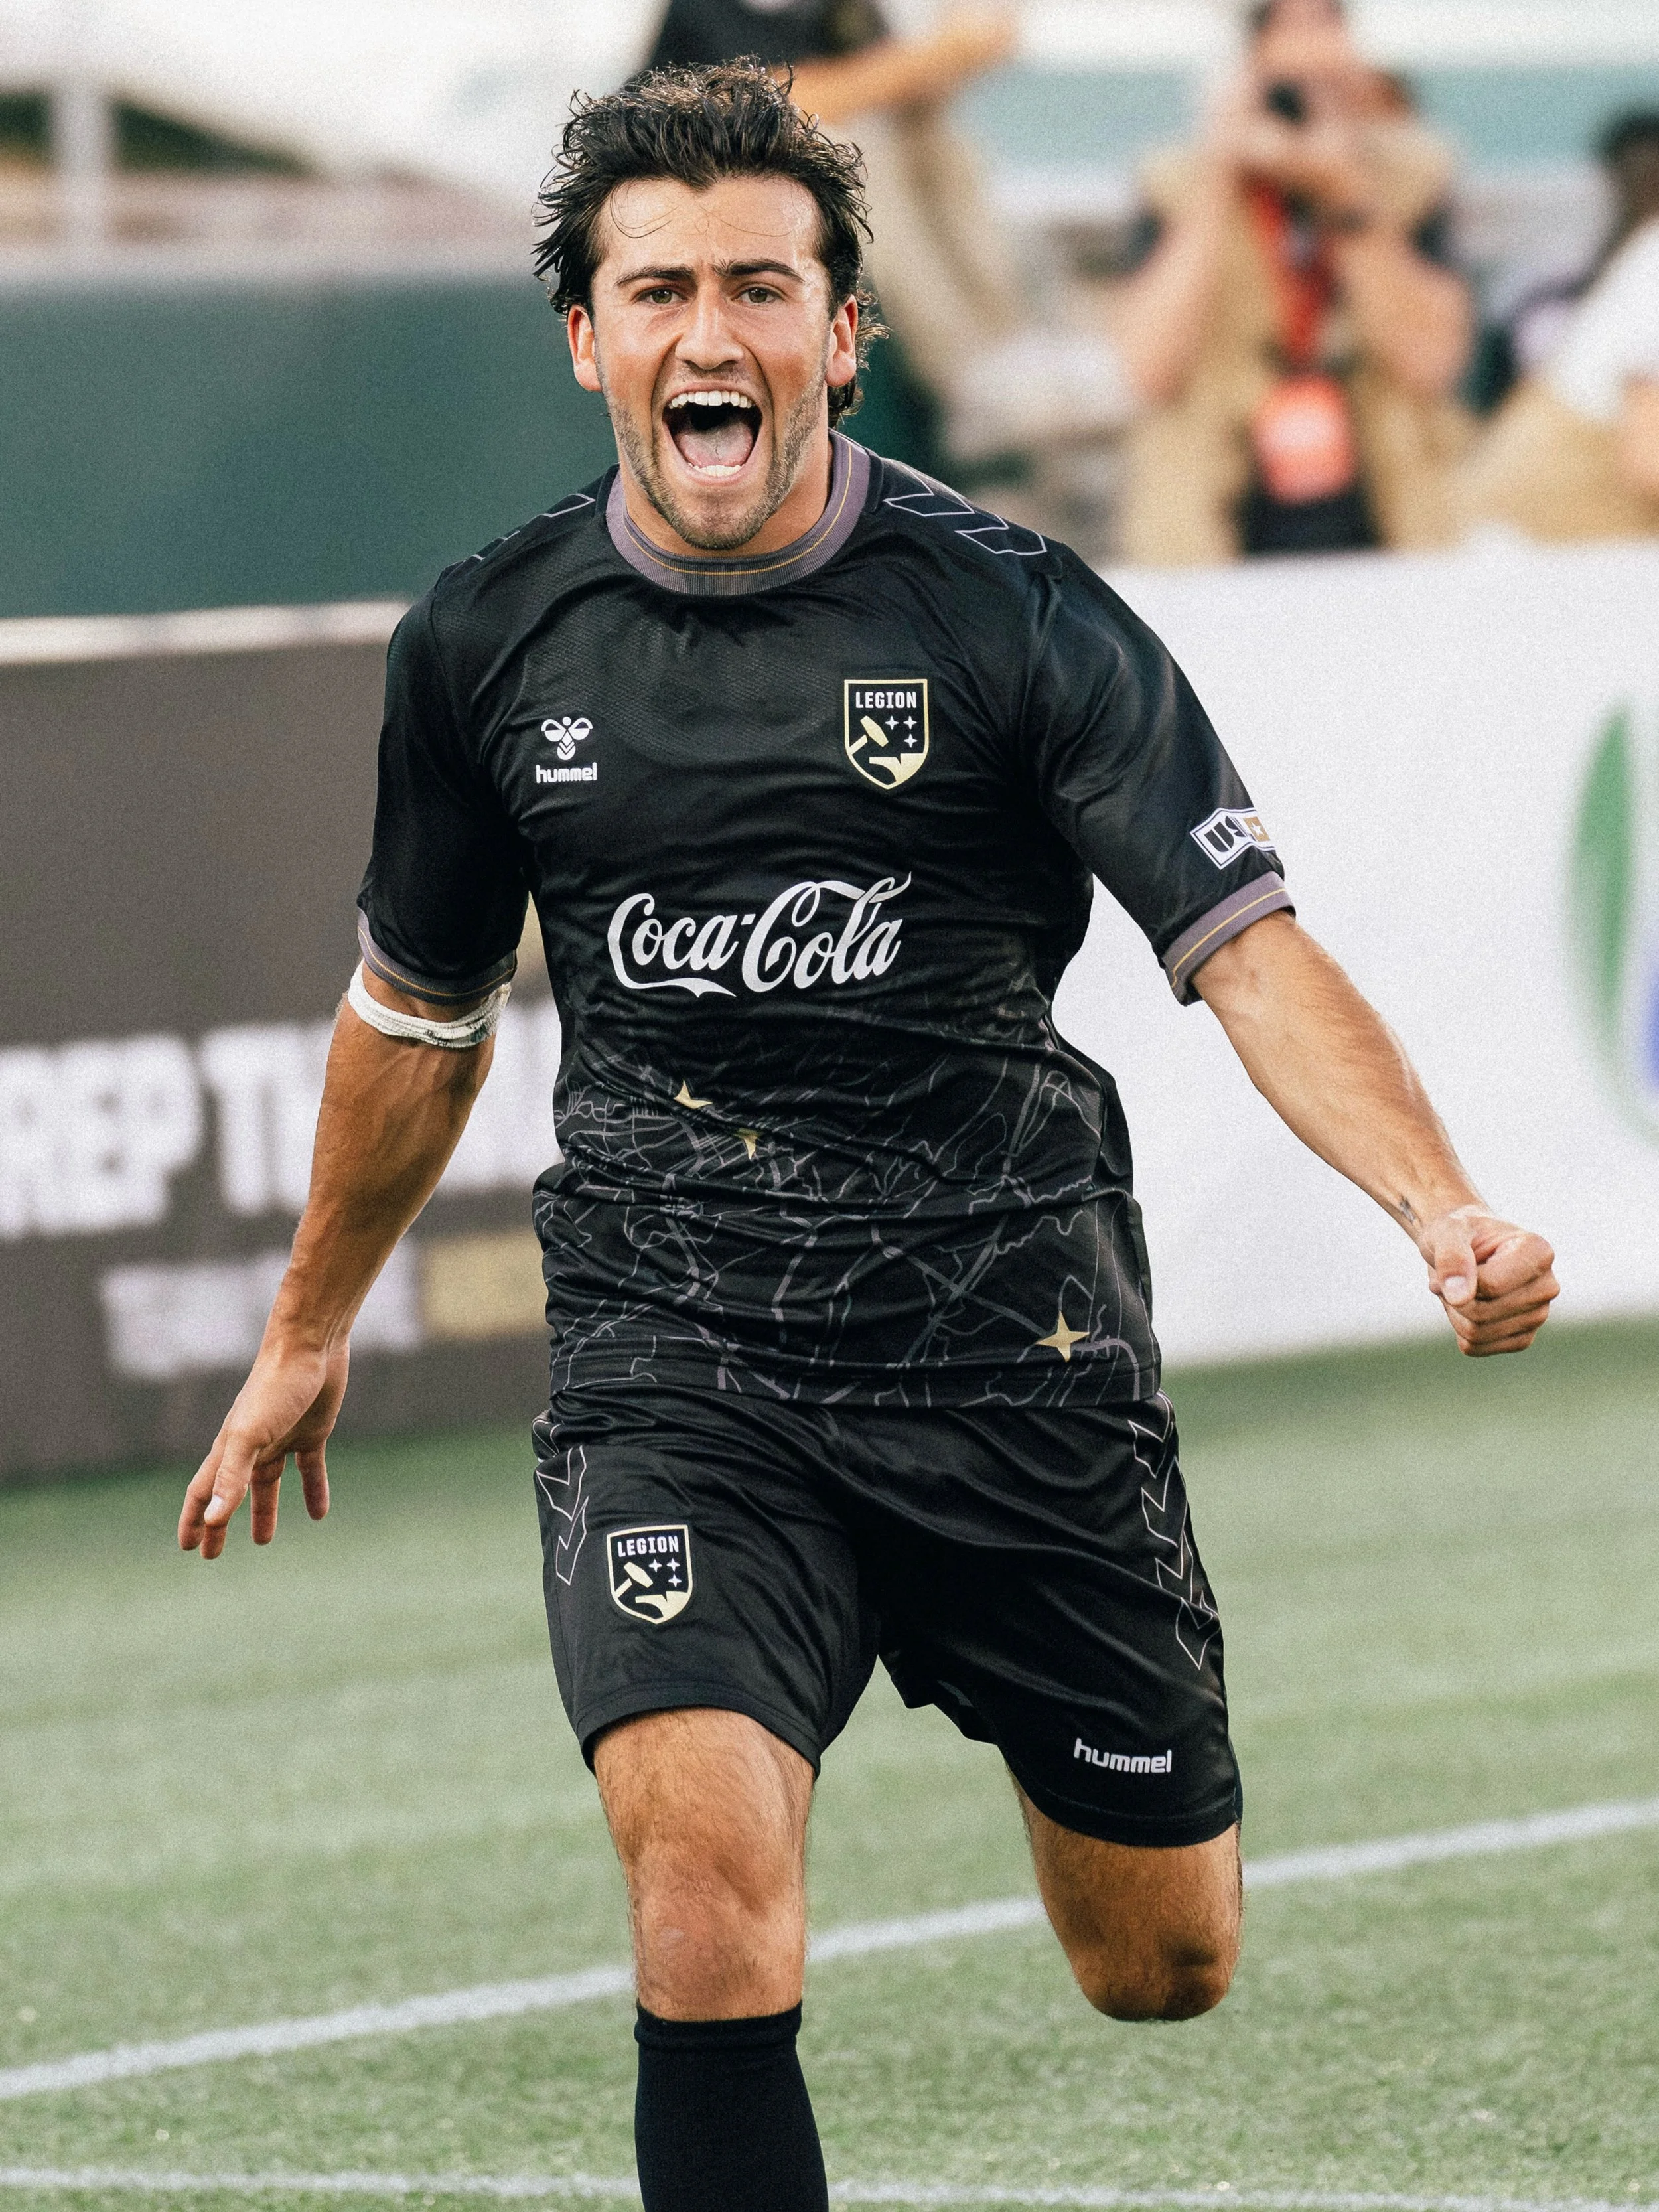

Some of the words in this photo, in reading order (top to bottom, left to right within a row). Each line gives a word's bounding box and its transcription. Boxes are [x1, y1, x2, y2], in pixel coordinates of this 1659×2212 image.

[855, 692, 916, 709] LEGION
[535, 762, 597, 784] hummel
[607, 871, 912, 998] Coca-Cola
[617, 1535, 679, 1558] LEGION
[1073, 1737, 1172, 1773] hummel
